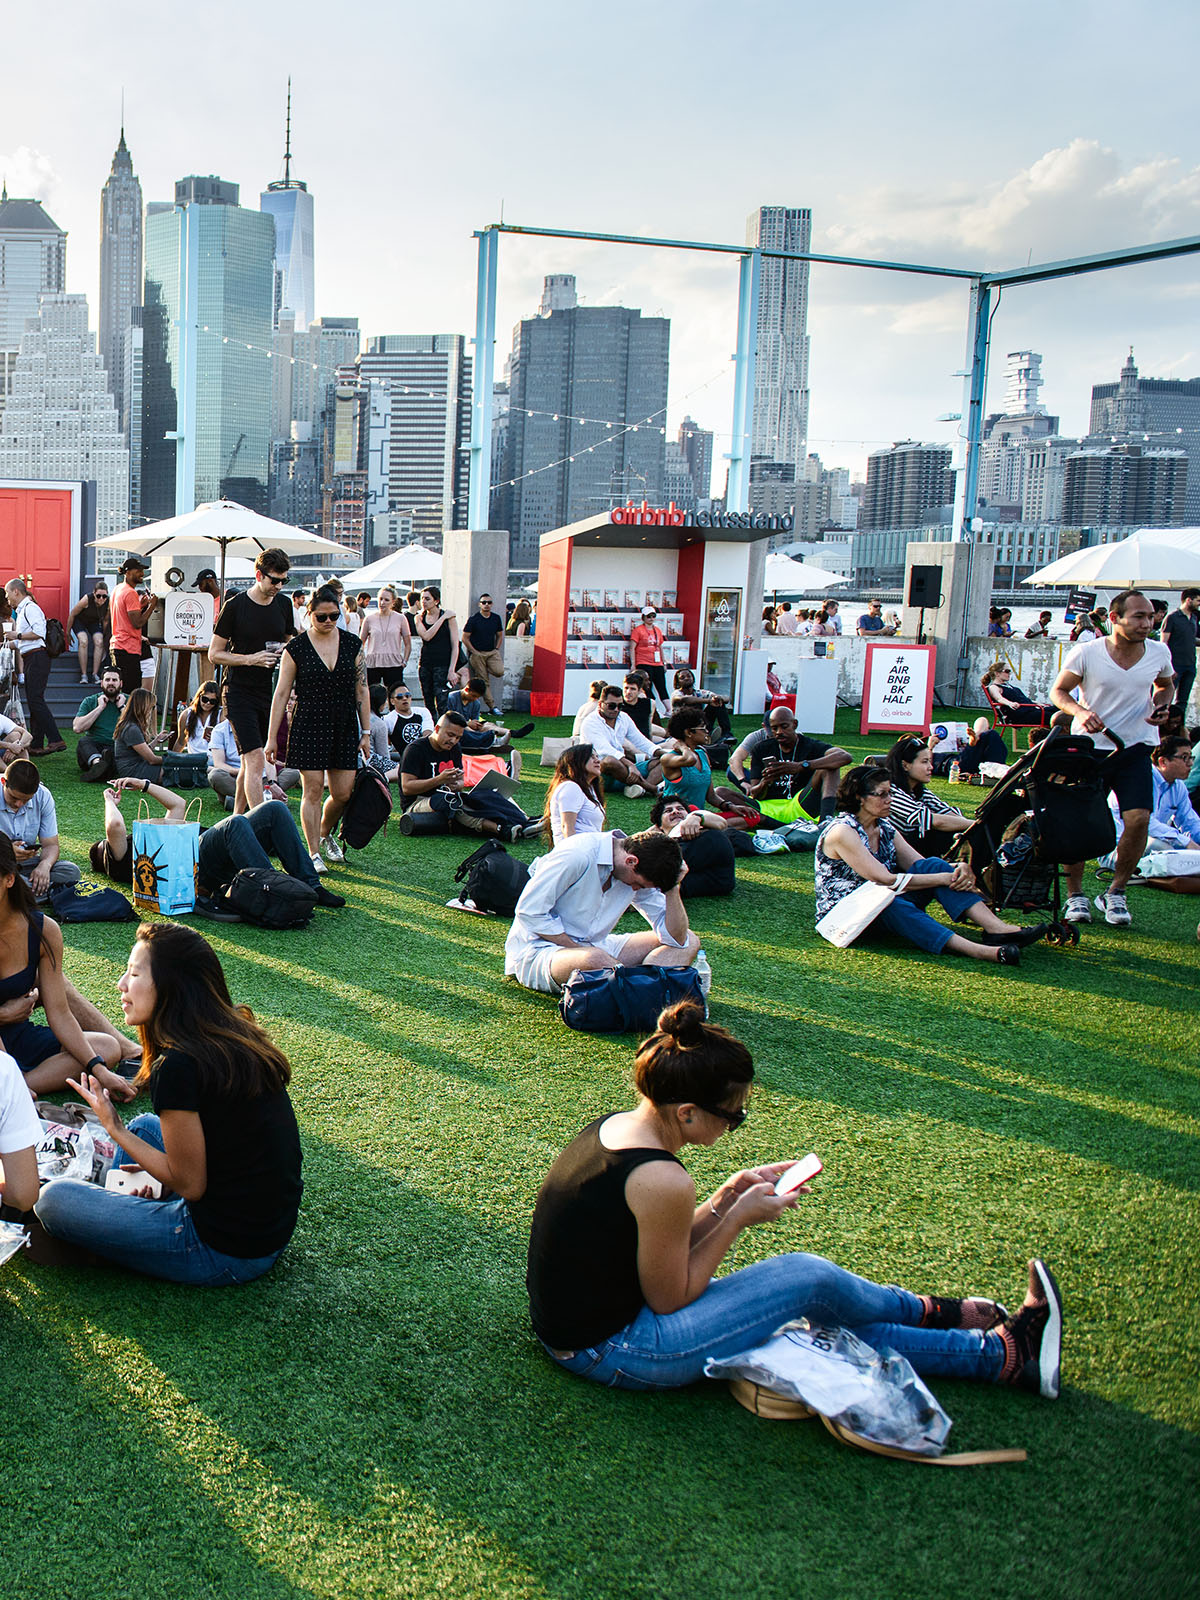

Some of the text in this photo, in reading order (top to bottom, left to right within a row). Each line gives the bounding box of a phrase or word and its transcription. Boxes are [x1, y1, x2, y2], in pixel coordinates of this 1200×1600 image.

[611, 500, 795, 530] airbnb newsstand
[896, 656, 904, 664] #
[889, 665, 909, 674] AIR
[887, 675, 911, 684] BNB
[890, 685, 906, 694] BK
[882, 695, 913, 704] HALF
